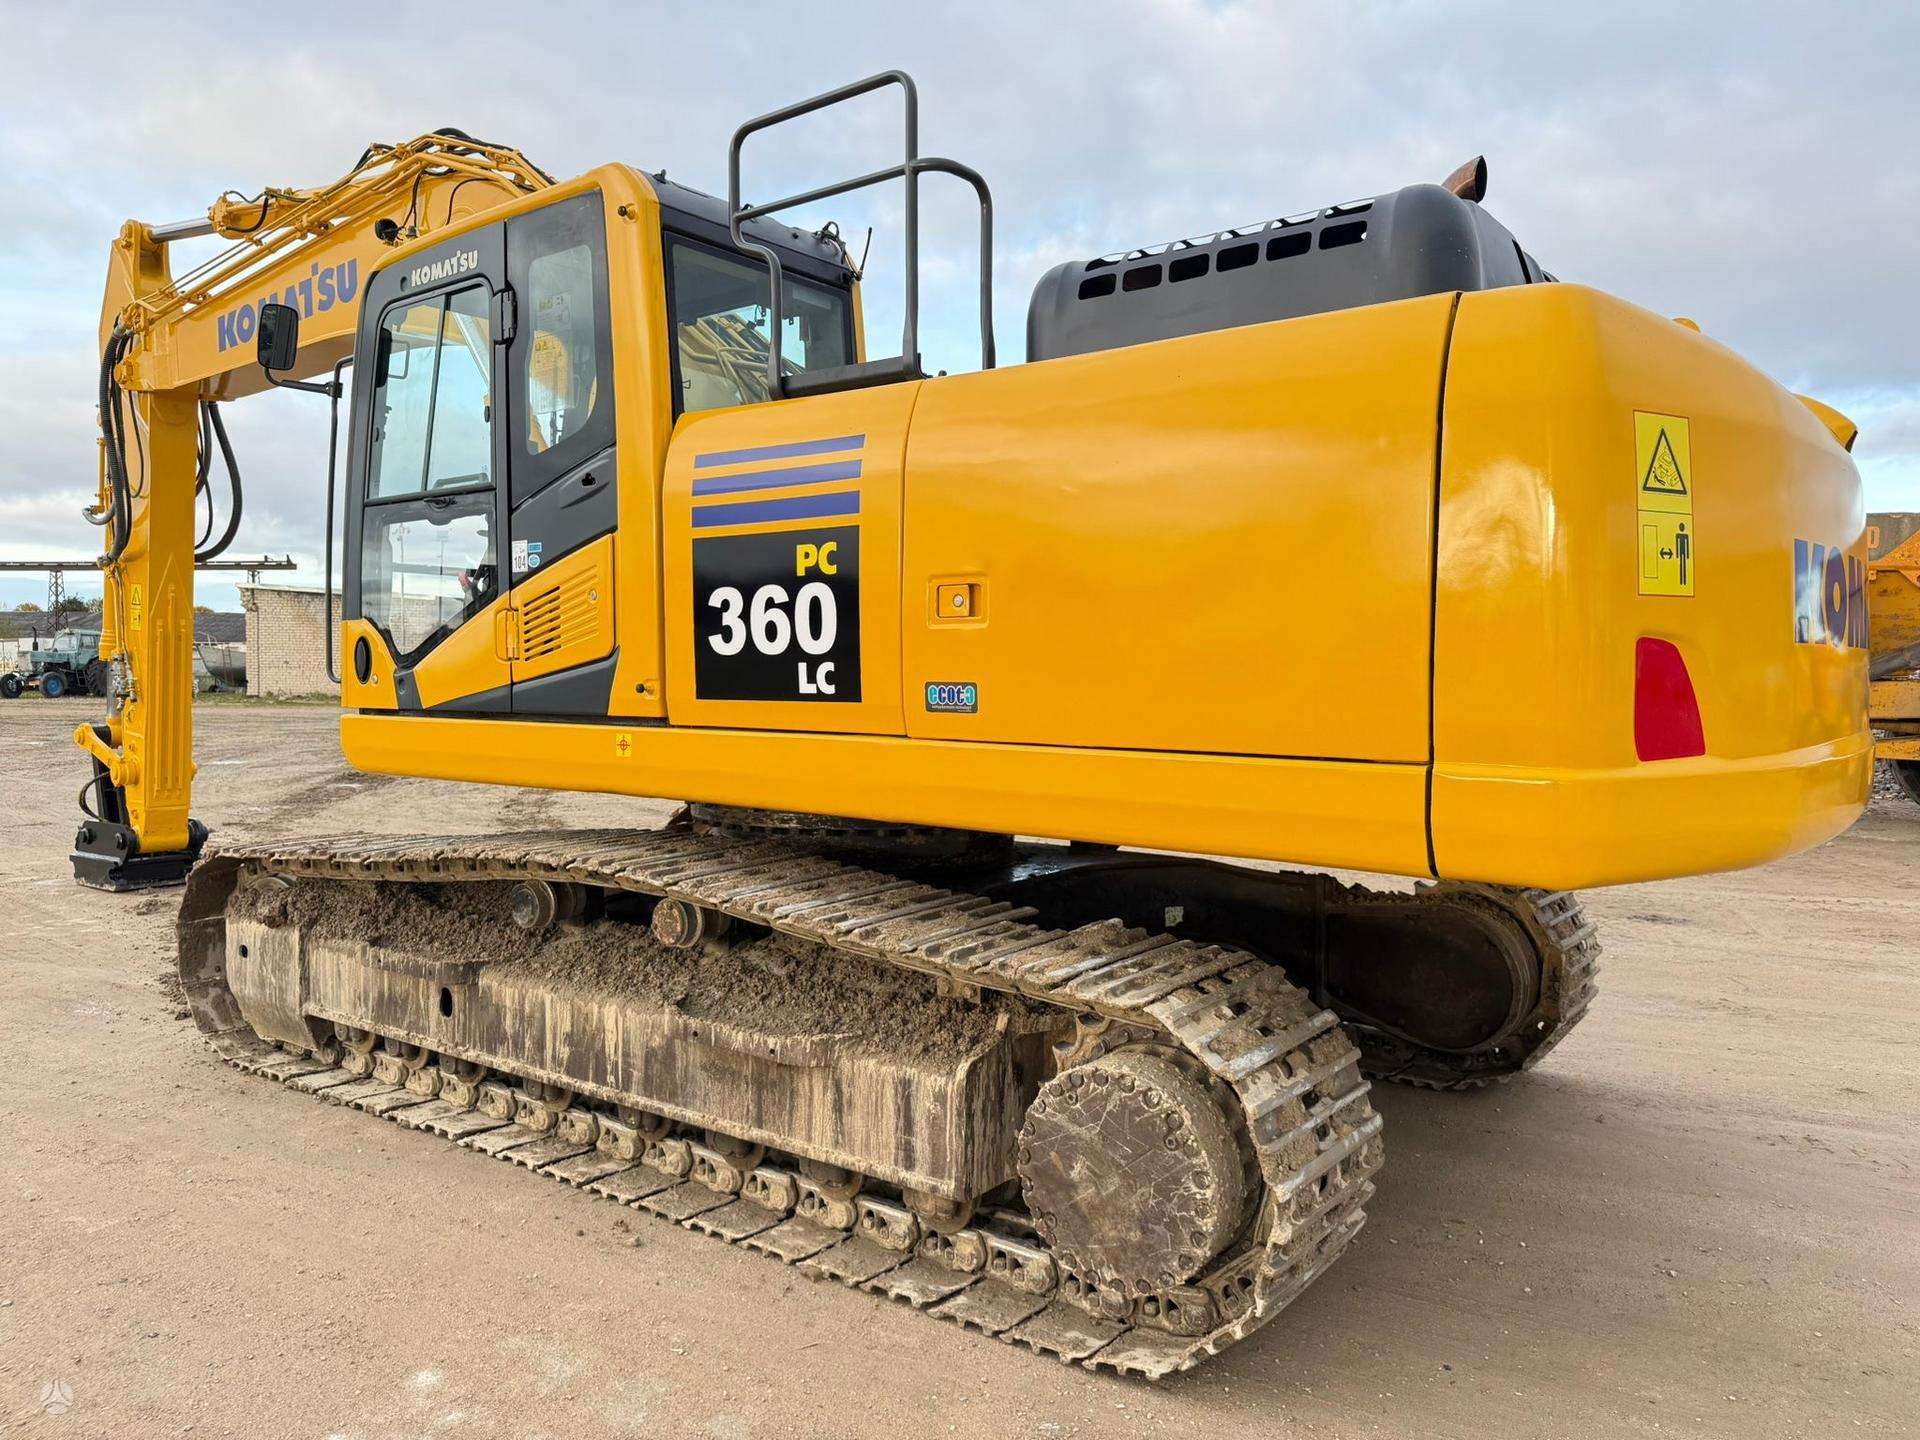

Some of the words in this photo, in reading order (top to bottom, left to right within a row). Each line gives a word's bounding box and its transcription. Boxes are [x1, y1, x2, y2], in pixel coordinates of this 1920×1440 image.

[411, 249, 478, 287] KOMATSU
[217, 258, 358, 352] KOATSU
[796, 541, 837, 576] PC
[708, 581, 837, 656] 360
[798, 661, 836, 694] LC
